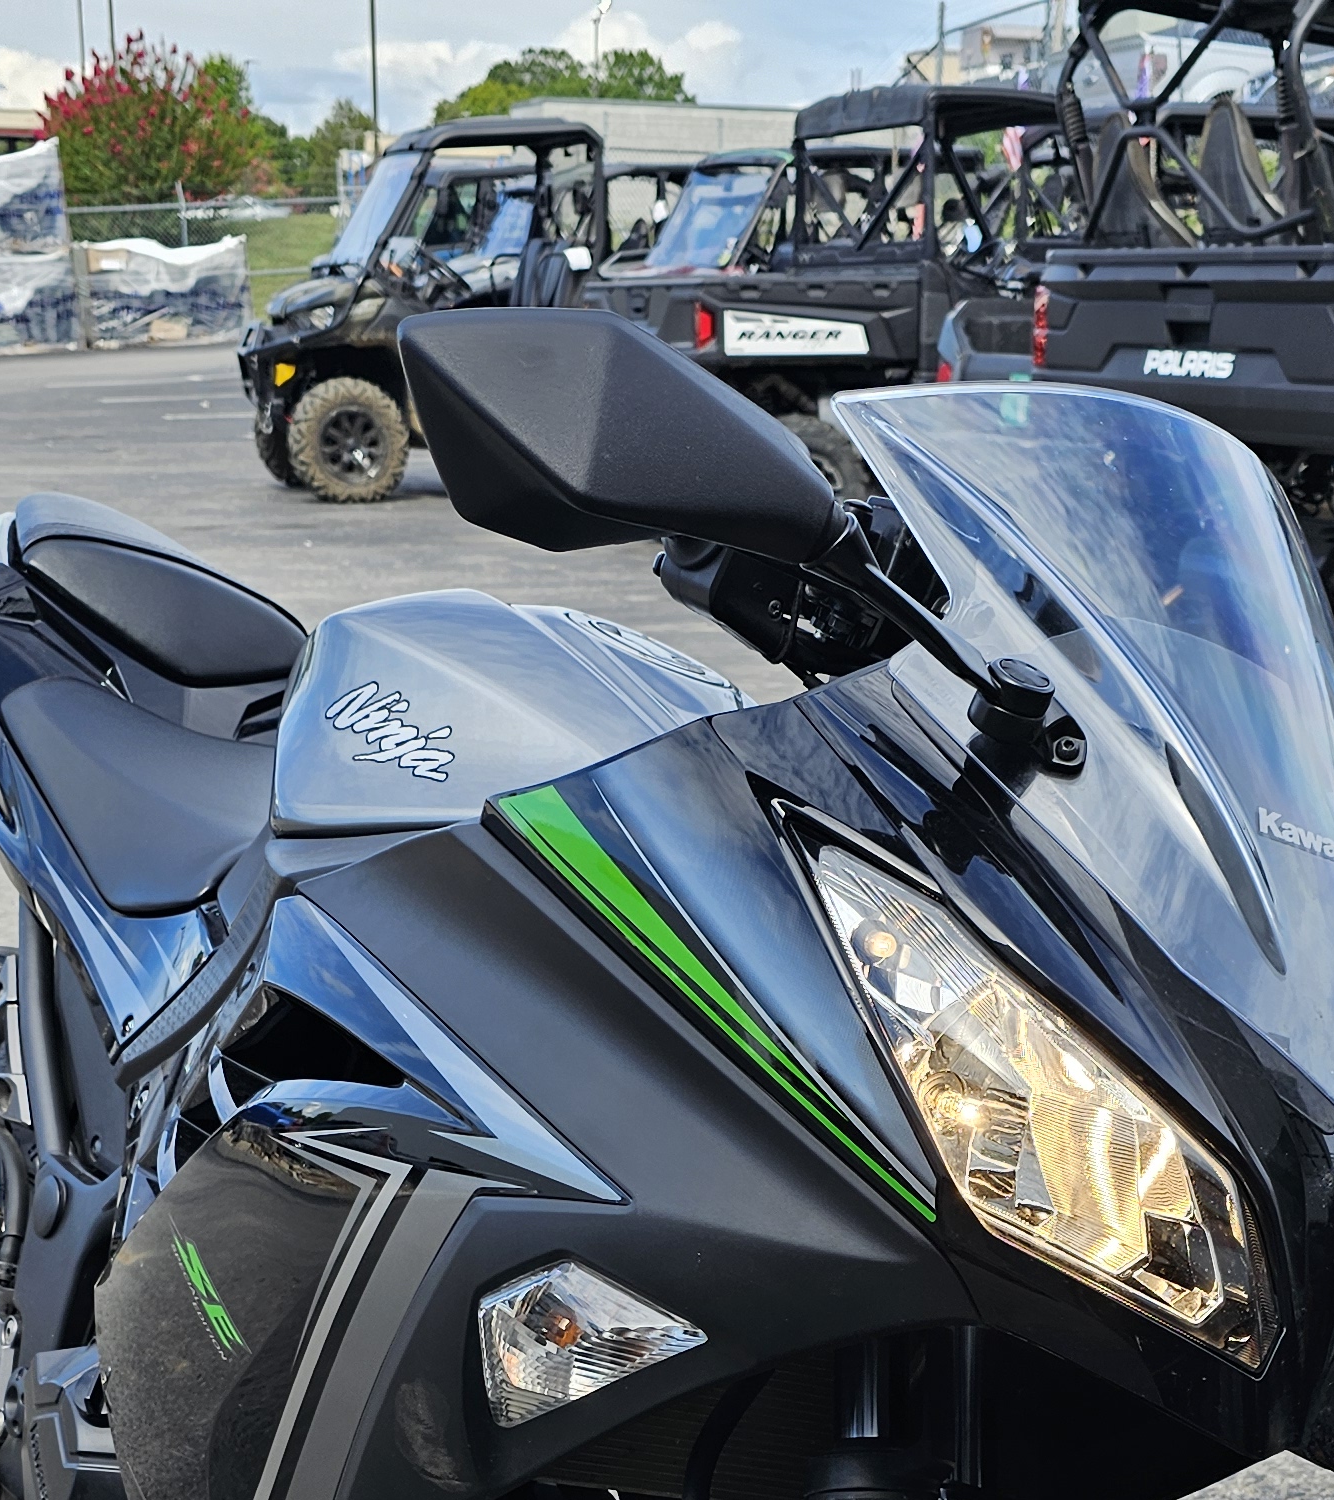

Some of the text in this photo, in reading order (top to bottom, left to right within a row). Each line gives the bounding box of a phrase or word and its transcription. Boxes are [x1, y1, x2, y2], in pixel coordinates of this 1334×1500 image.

[737, 329, 843, 342] RANGER
[1143, 350, 1236, 378] POLARIS
[325, 681, 455, 782] Ninja
[192, 1301, 228, 1362] EDITION
